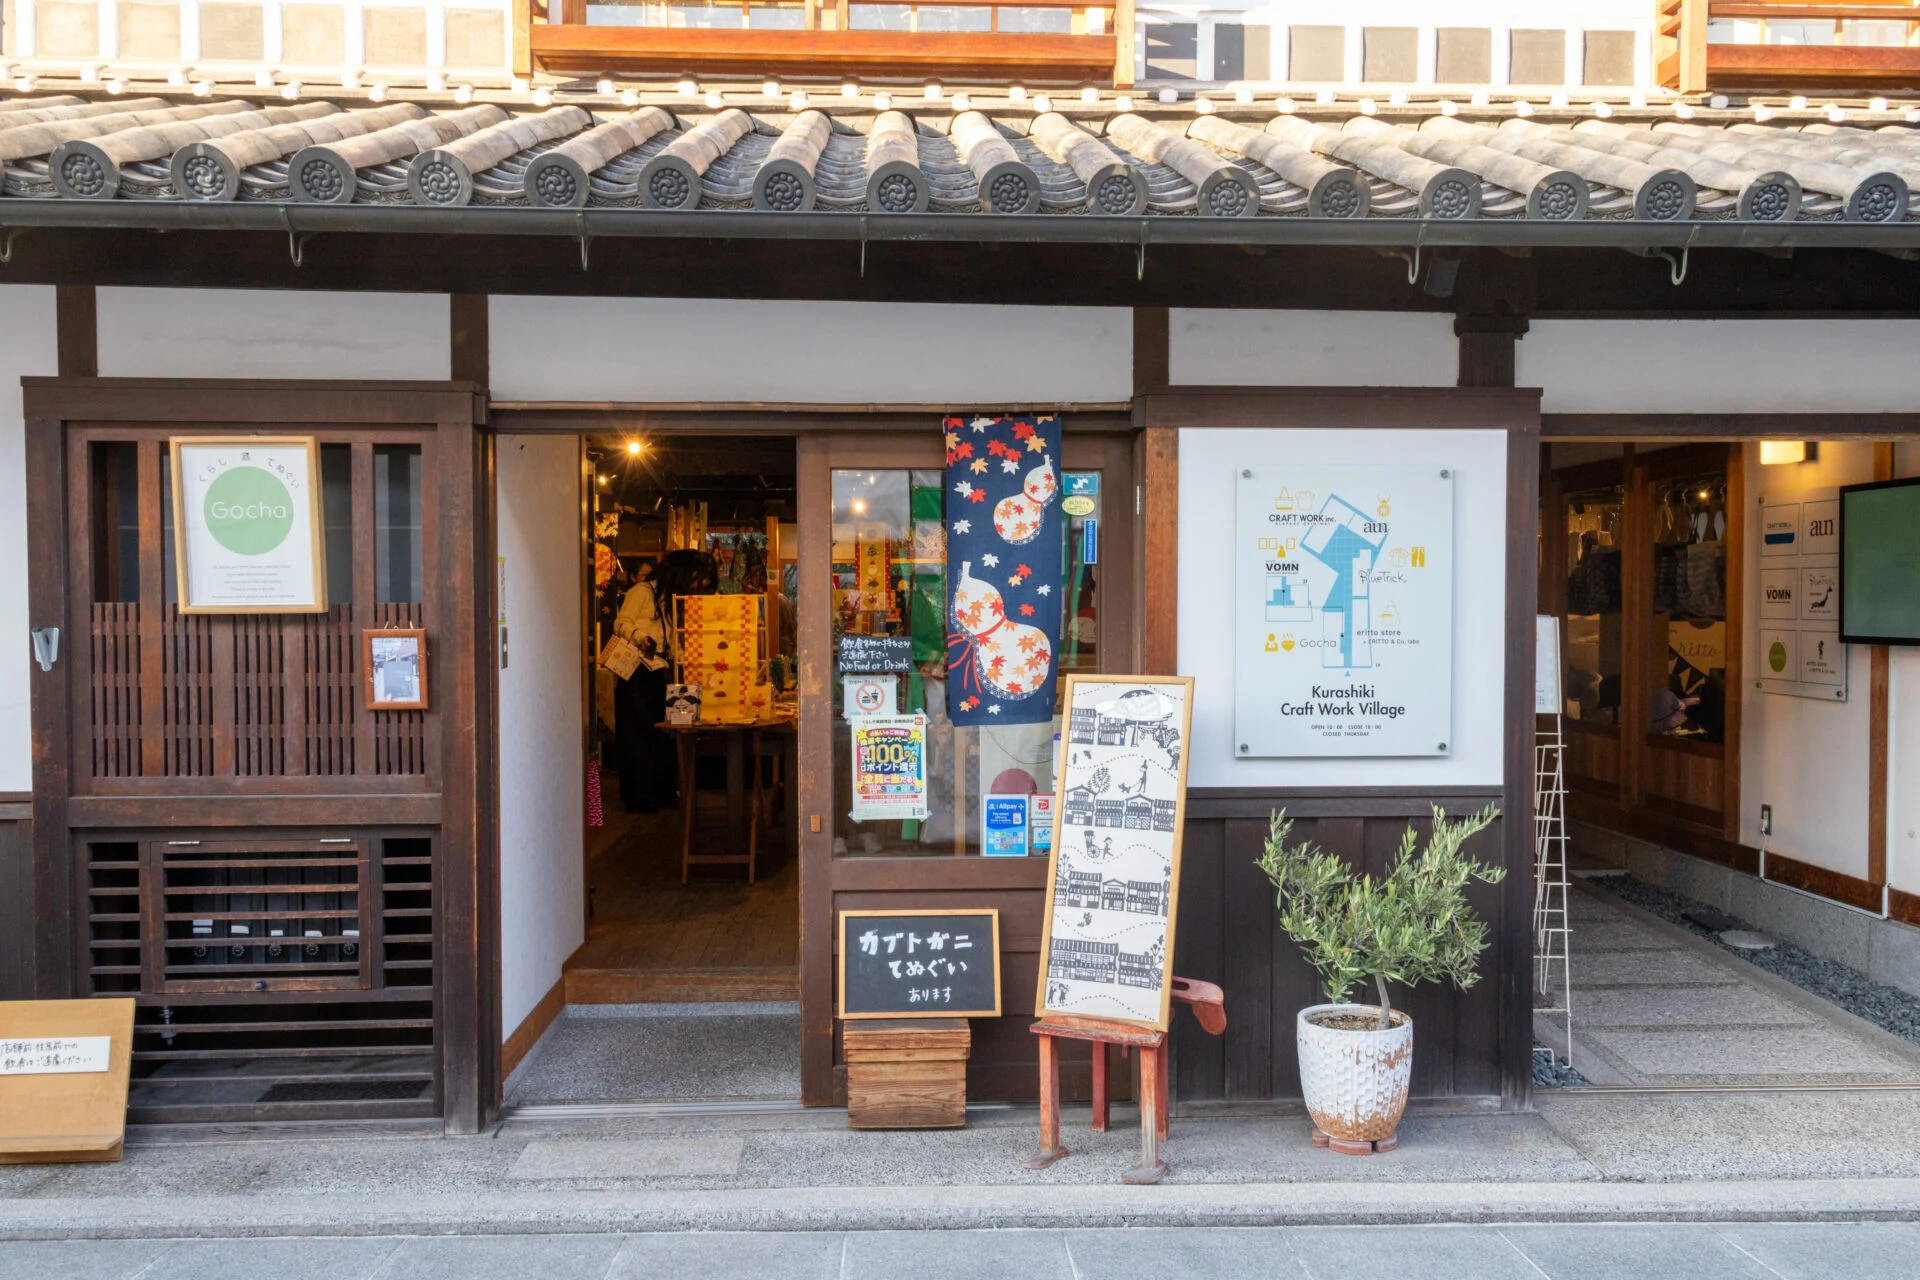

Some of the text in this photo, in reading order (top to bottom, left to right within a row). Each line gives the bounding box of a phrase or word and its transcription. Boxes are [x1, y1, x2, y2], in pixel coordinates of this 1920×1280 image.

[211, 501, 287, 519] Gocha
[1269, 514, 1298, 522] CRAFT
[1299, 514, 1324, 522] WORK
[1266, 563, 1299, 571] VOMN
[1766, 590, 1791, 600] VOMN
[1300, 638, 1337, 648] Gocha
[840, 661, 853, 671] No
[853, 660, 870, 671] Food
[884, 657, 910, 671] Drink
[1312, 684, 1374, 698] Kurashiki
[1281, 701, 1405, 719] Craft Work Village
[860, 762, 918, 772] dポイント還元
[859, 931, 973, 956] カブトガニ
[888, 958, 968, 979] てぬぐい
[908, 986, 952, 1003] あります
